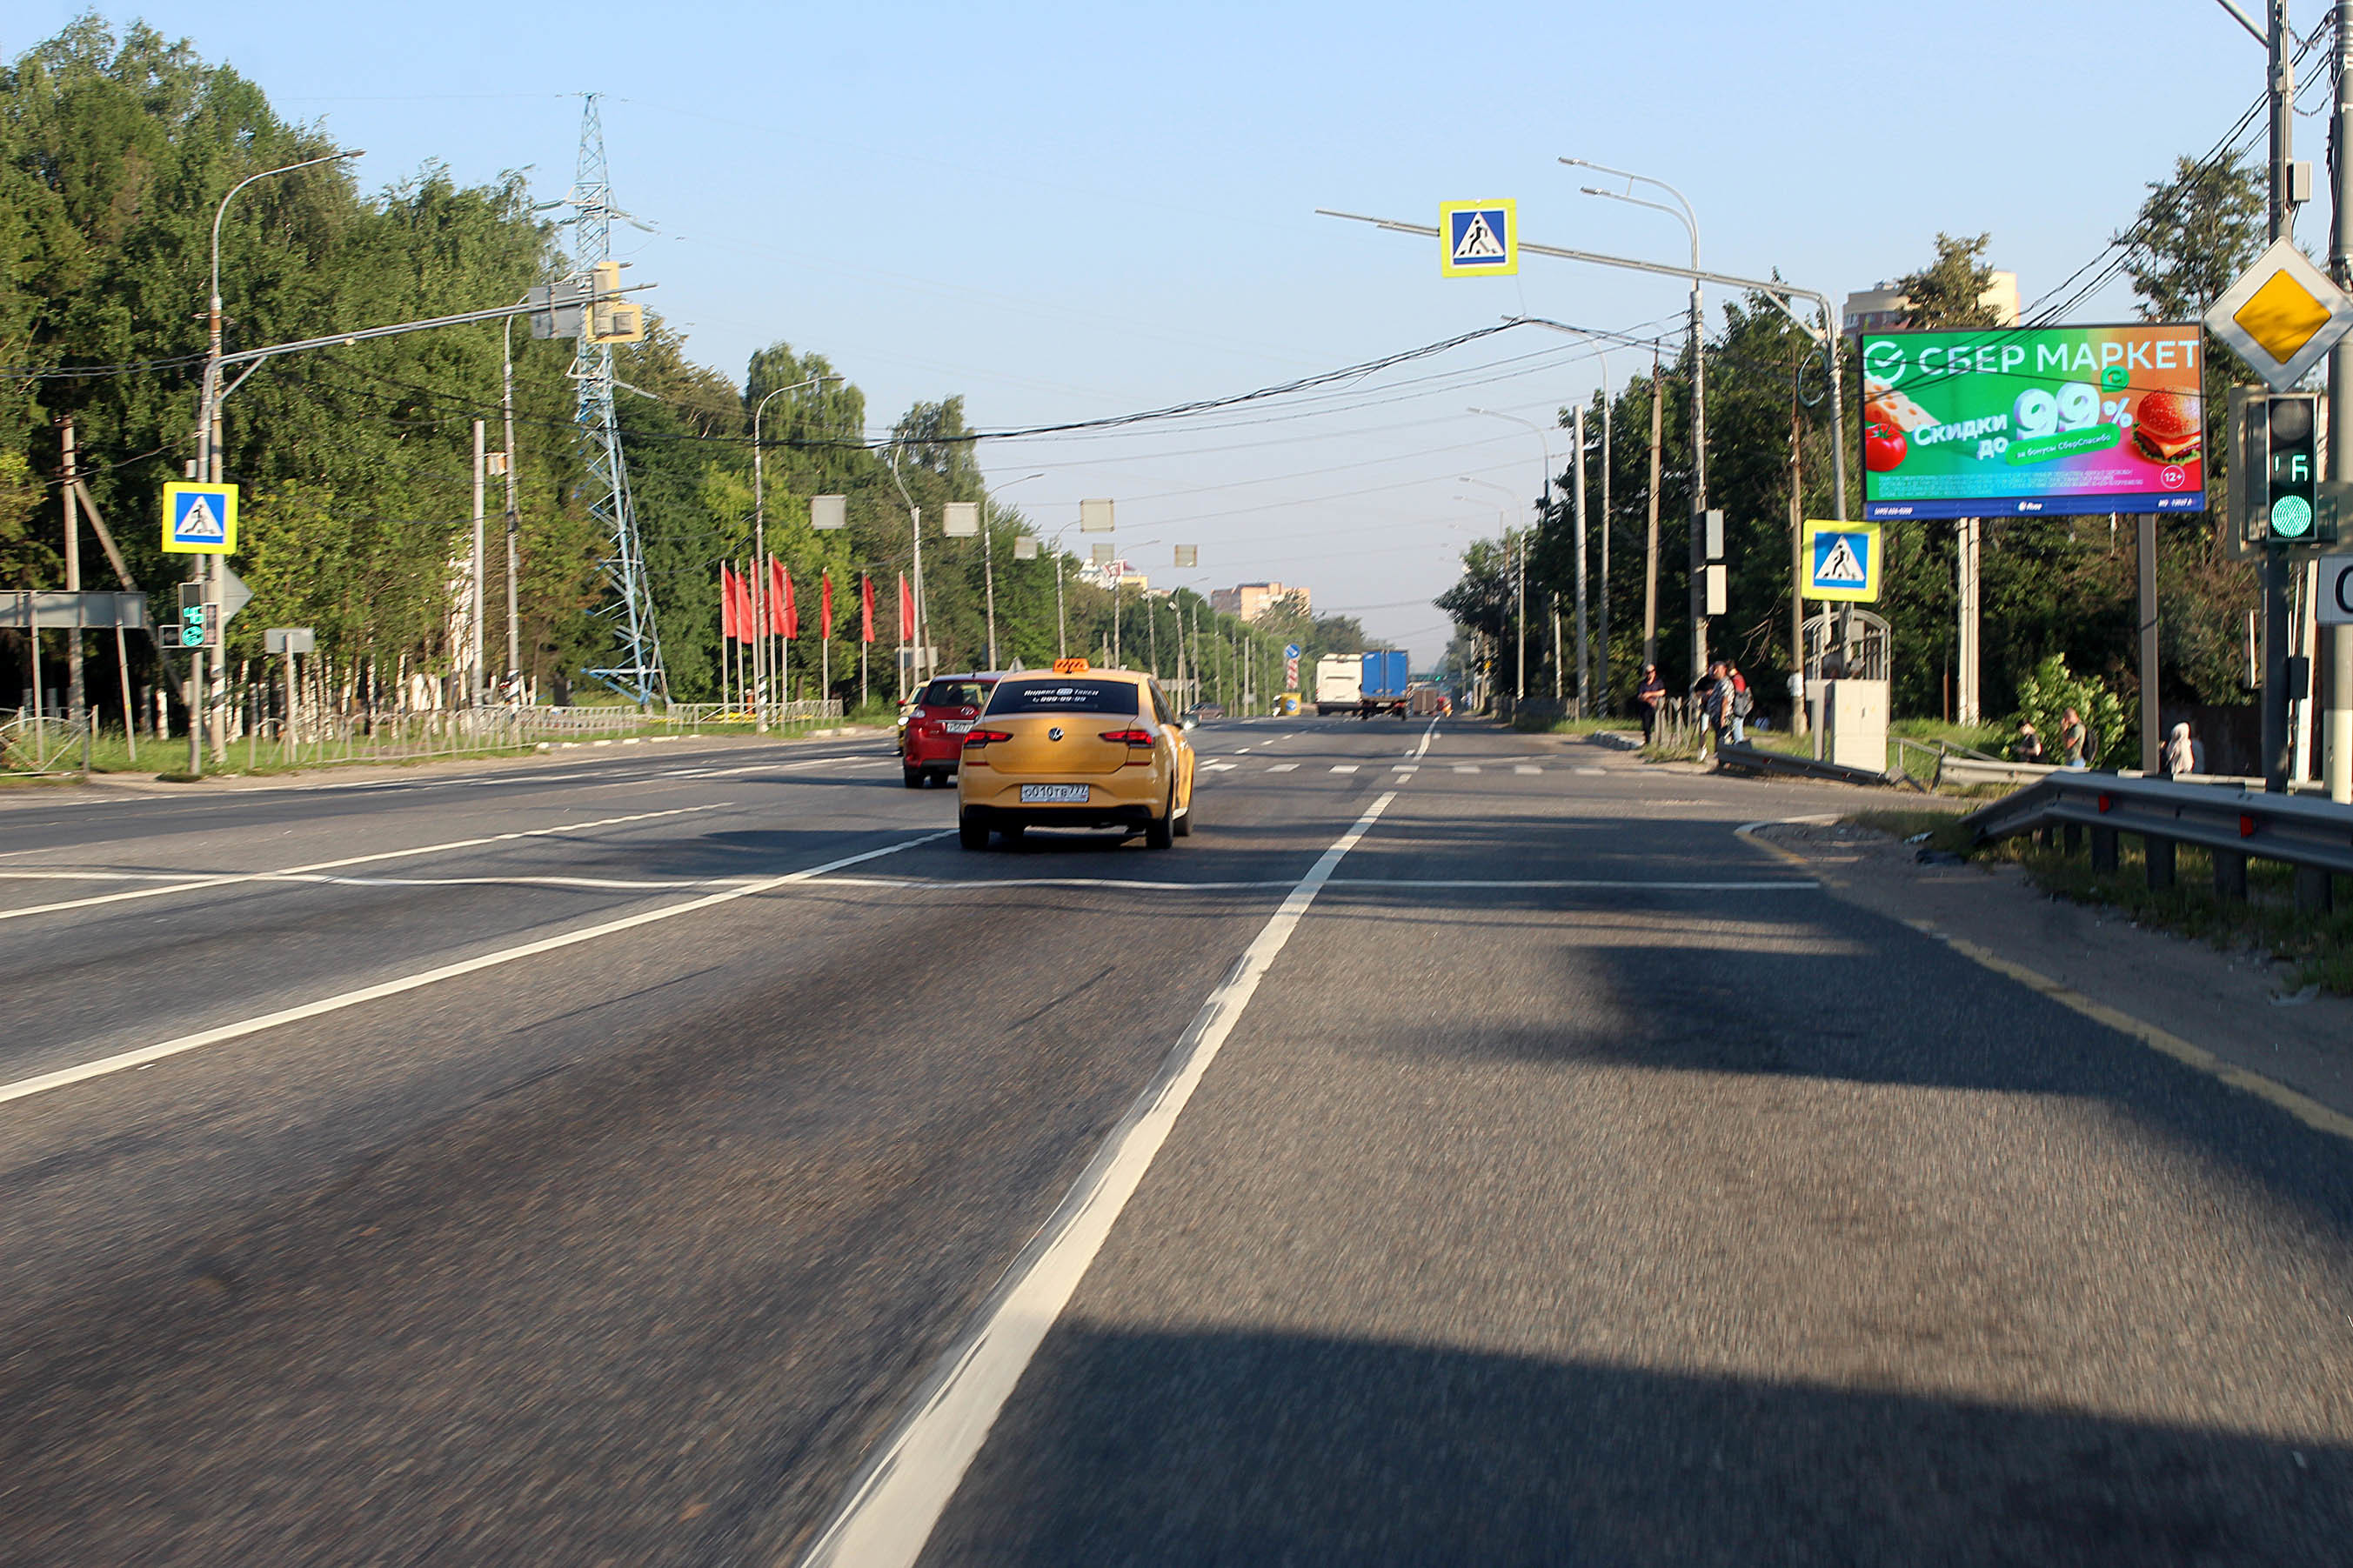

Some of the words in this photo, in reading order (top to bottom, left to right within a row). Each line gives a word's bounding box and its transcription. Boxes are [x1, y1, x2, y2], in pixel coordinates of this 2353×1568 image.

[1919, 344, 2026, 376] СБЕР
[2036, 340, 2200, 372] МАРКЕТ
[1913, 414, 2009, 446] Скидки
[1976, 436, 2009, 461] до
[2027, 444, 2056, 456] бонусы
[2057, 433, 2111, 450] СберСпасибо
[2164, 470, 2183, 483] 12+
